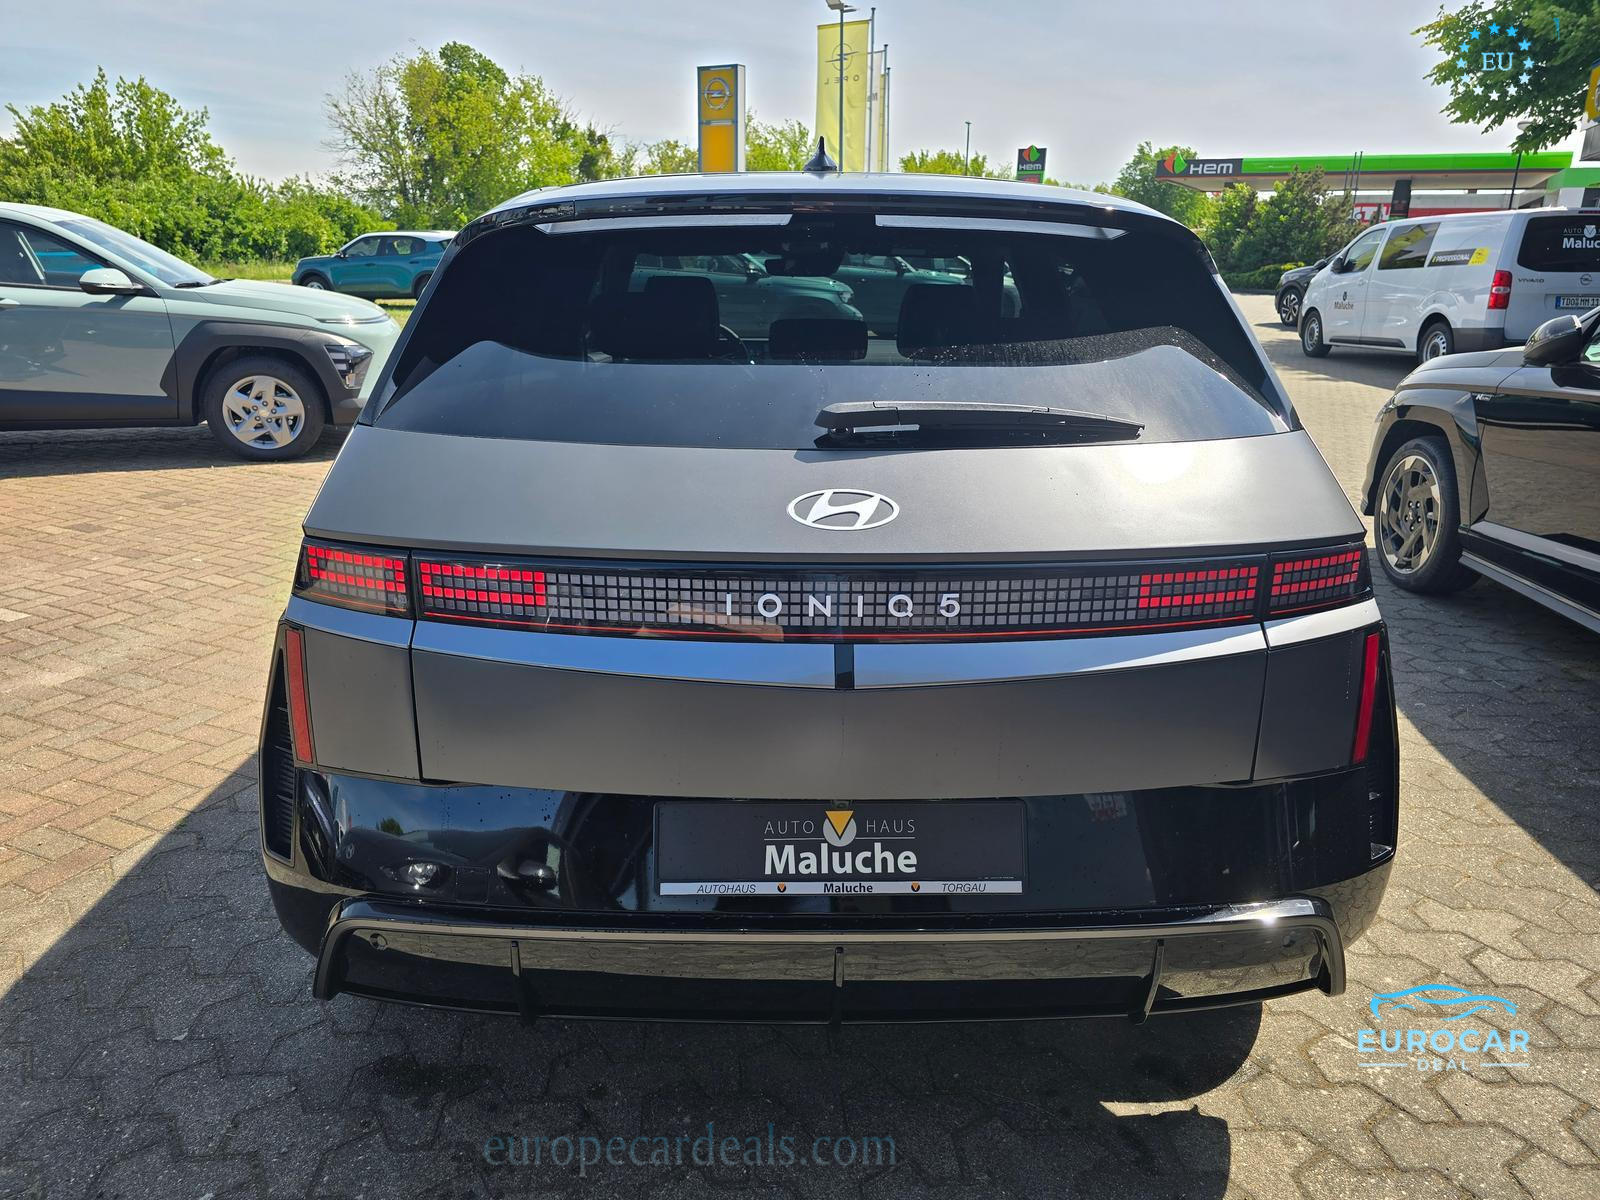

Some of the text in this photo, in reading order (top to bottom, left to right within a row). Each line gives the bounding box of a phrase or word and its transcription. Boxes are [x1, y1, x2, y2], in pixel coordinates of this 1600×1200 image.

[764, 818, 916, 835] AUTO HAUS
[764, 842, 918, 876] Maluche
[696, 882, 987, 894] AUTOHAUS Maluche TORGAU
